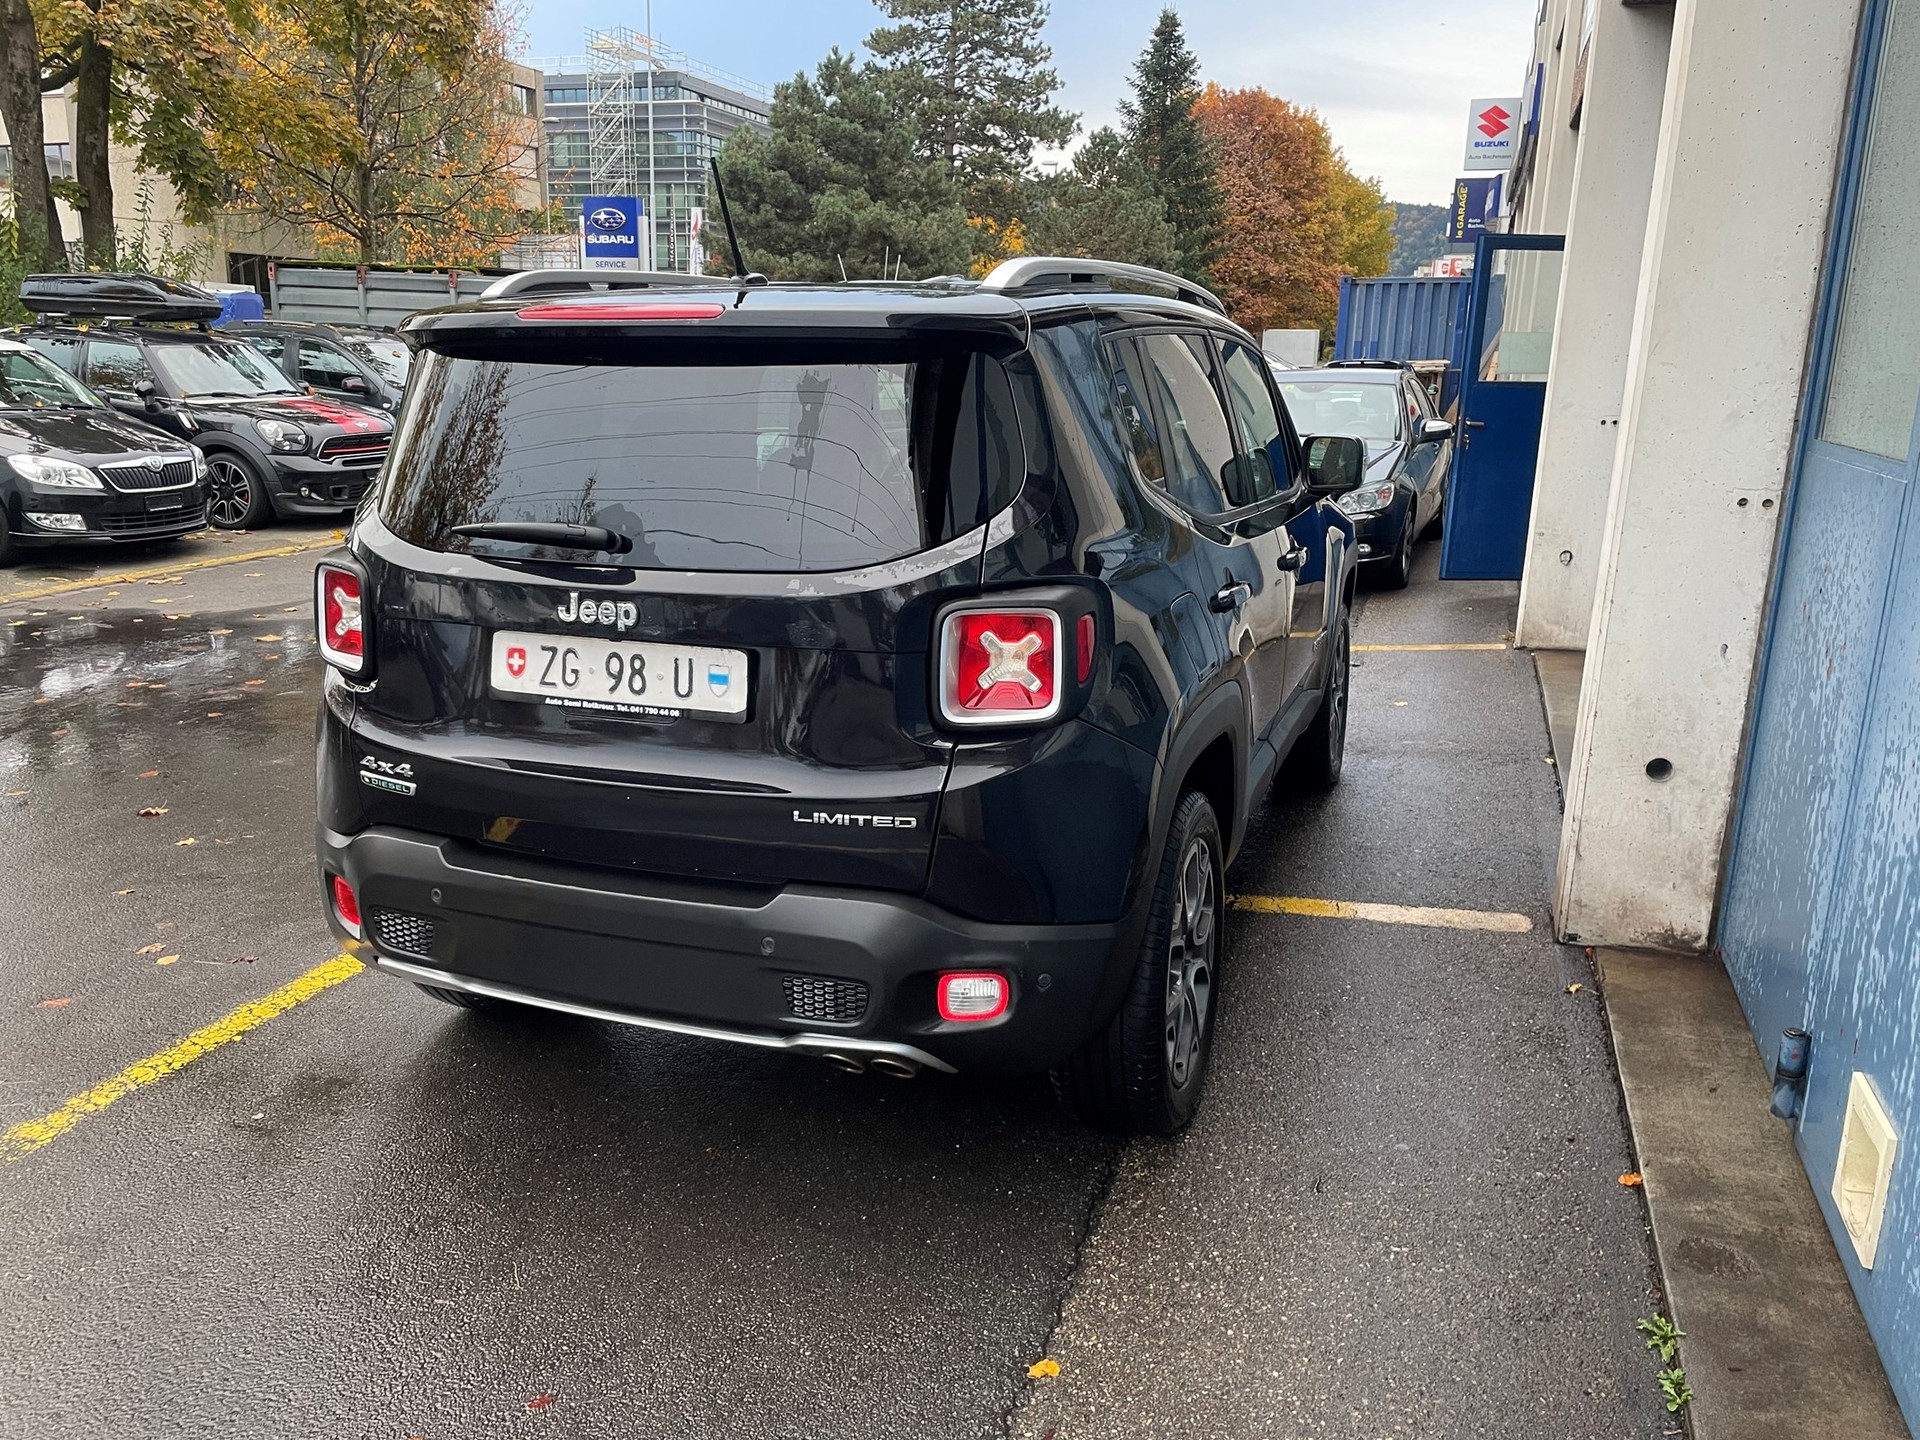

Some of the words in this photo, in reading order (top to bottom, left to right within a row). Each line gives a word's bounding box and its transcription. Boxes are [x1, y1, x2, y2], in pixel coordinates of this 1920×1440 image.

[1457, 187, 1468, 229] GARAGE
[588, 235, 634, 244] SUBARU
[557, 590, 639, 632] Jeep
[539, 644, 580, 689] ZG
[605, 651, 647, 696] 98
[673, 656, 694, 699] U
[544, 697, 563, 706] Auto
[793, 810, 917, 829] LIMITED
